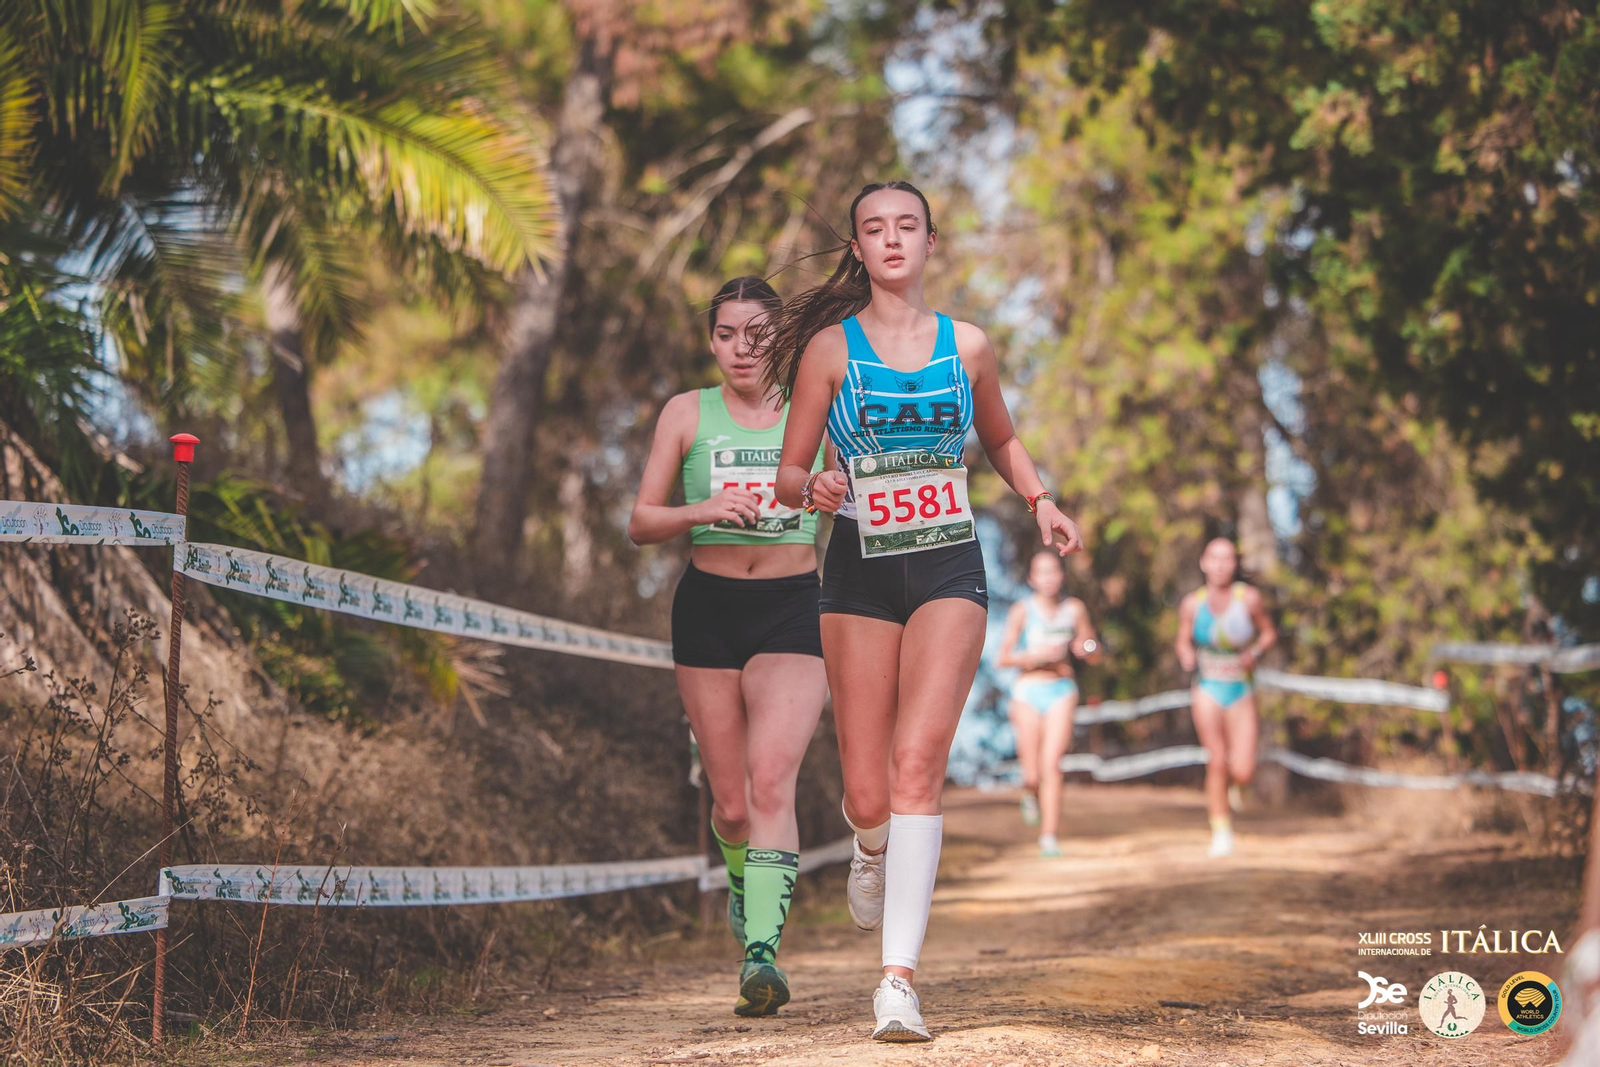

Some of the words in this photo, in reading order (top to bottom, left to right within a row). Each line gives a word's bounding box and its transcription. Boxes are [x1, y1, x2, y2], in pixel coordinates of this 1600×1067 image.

[859, 402, 962, 428] CAR
[851, 430, 871, 438] CLUB
[873, 425, 922, 436] ATLETISMO
[741, 450, 781, 462] ITÁLIC
[884, 453, 938, 468] ITÁLICA
[868, 481, 962, 527] 5581
